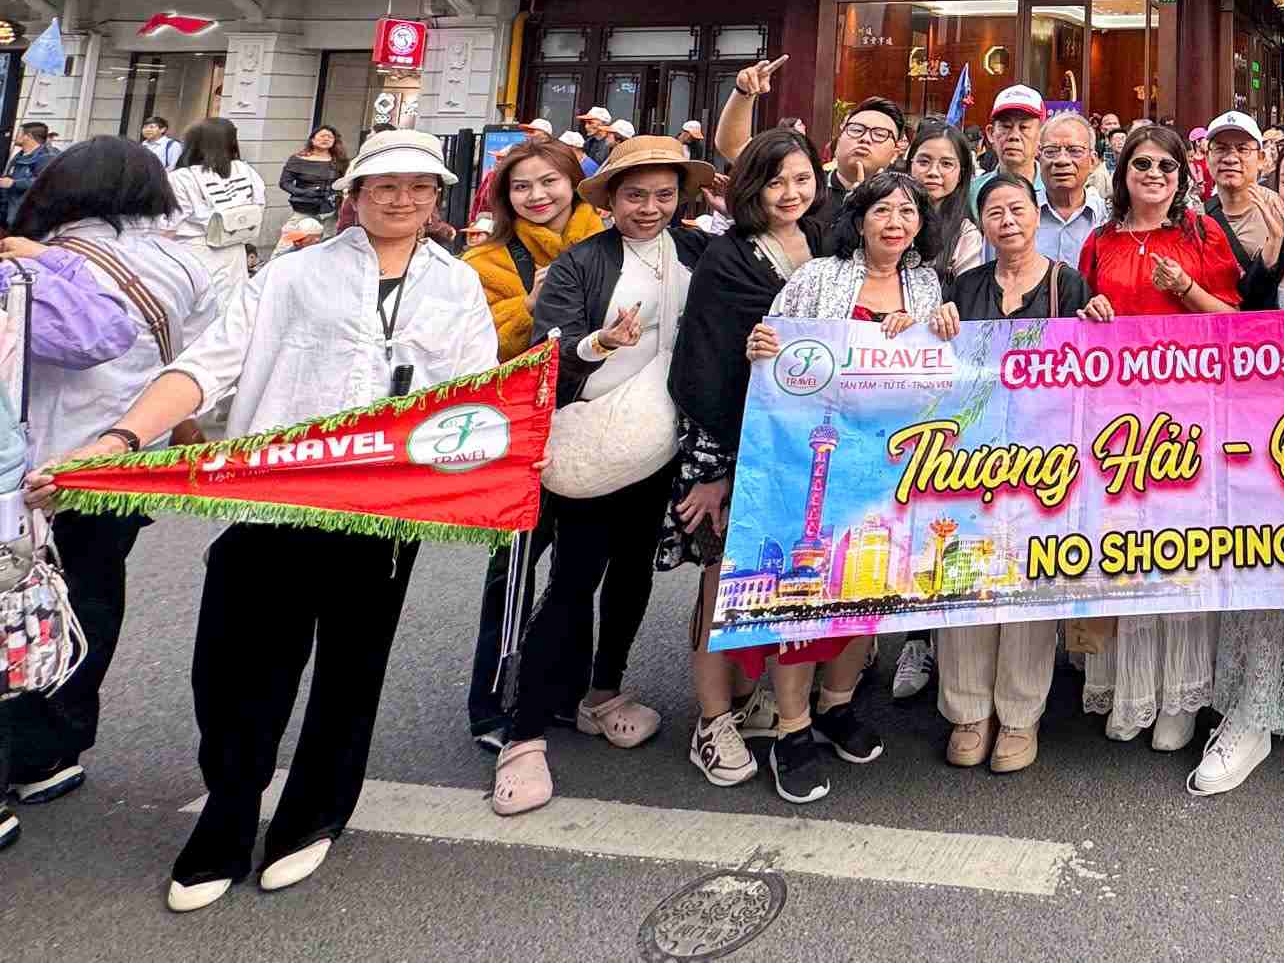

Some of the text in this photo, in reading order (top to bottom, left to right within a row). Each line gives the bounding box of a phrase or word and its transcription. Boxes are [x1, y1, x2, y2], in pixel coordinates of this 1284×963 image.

[786, 378, 817, 387] TRAVEL
[1004, 345, 1109, 384] CHÀO
[1122, 341, 1222, 382] MỪNG
[888, 419, 1079, 507] Thượng
[1092, 412, 1202, 495] Hải
[1223, 441, 1251, 457] -
[1028, 535, 1093, 579] NO
